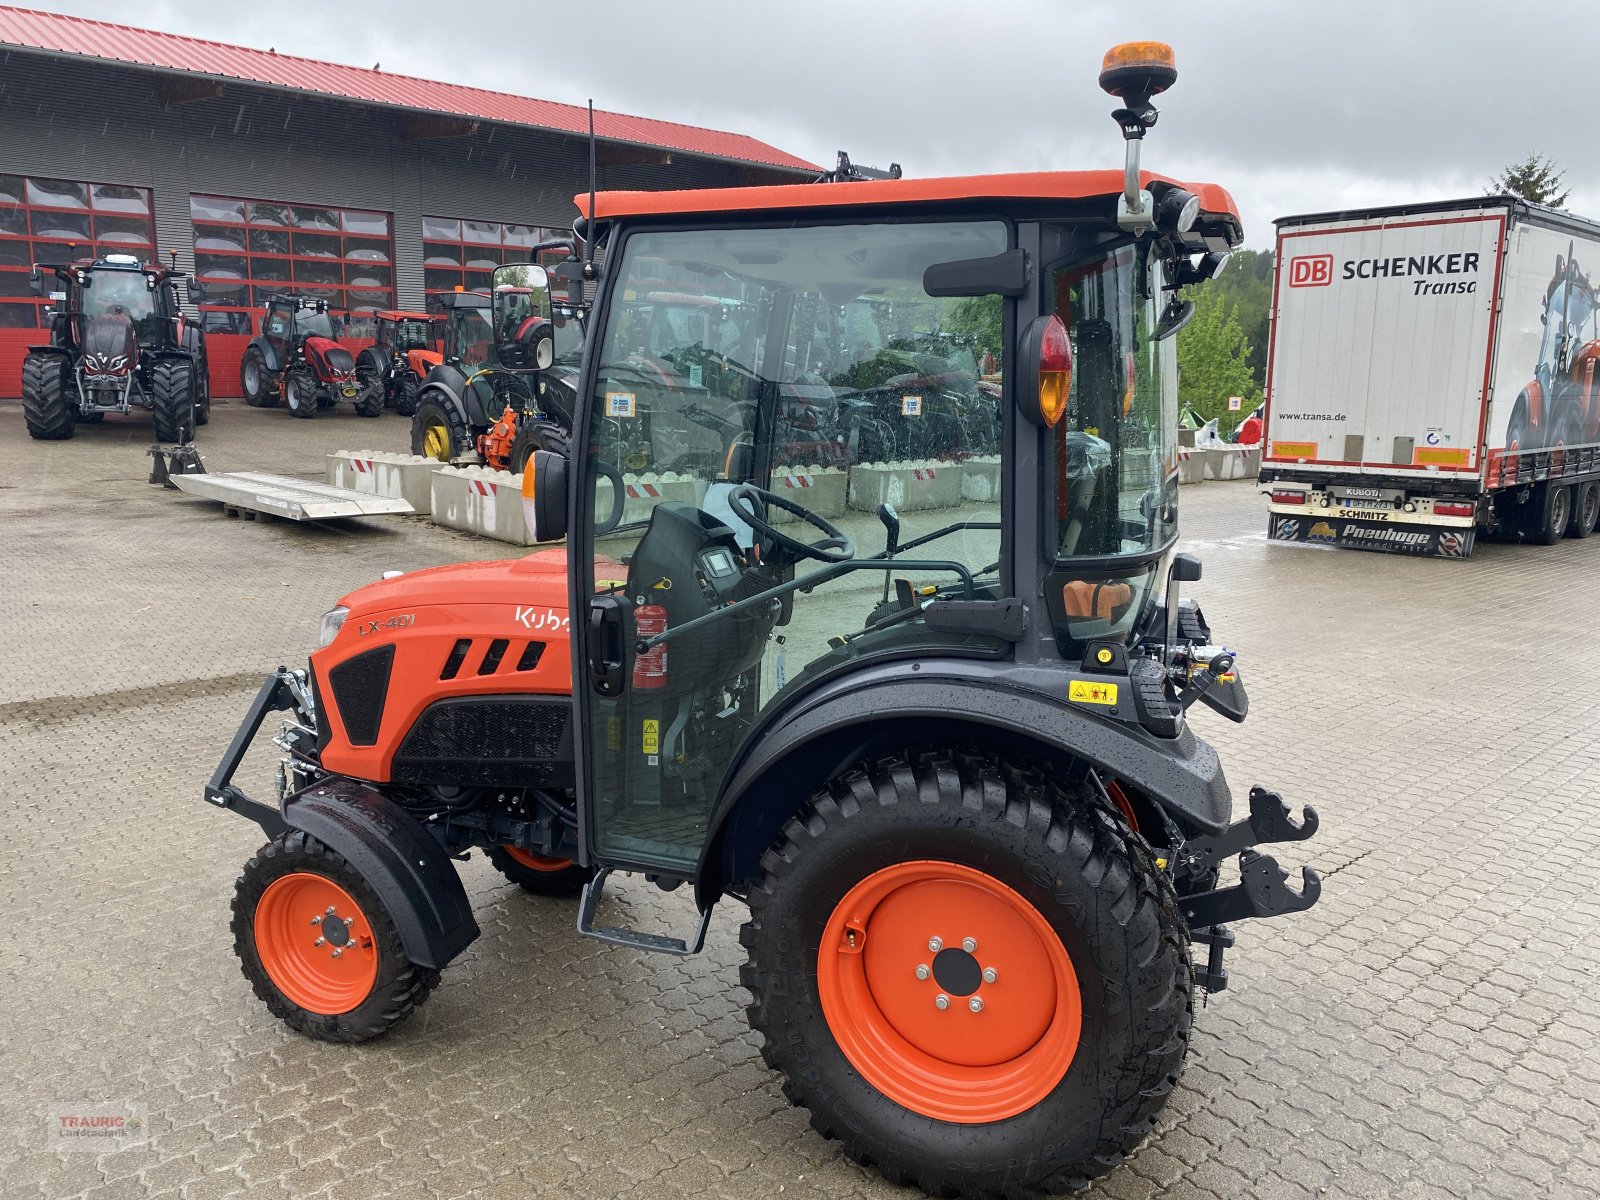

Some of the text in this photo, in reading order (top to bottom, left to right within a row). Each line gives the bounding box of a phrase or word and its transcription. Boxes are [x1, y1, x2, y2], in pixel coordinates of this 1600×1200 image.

[1294, 252, 1480, 283] DB SCHENKER
[1413, 279, 1477, 296] Transa
[1279, 412, 1347, 422] www.transa.de
[1346, 488, 1382, 497] KUBOTA
[1339, 509, 1388, 520] SCHMITZ
[1342, 524, 1431, 545] Pneuhage
